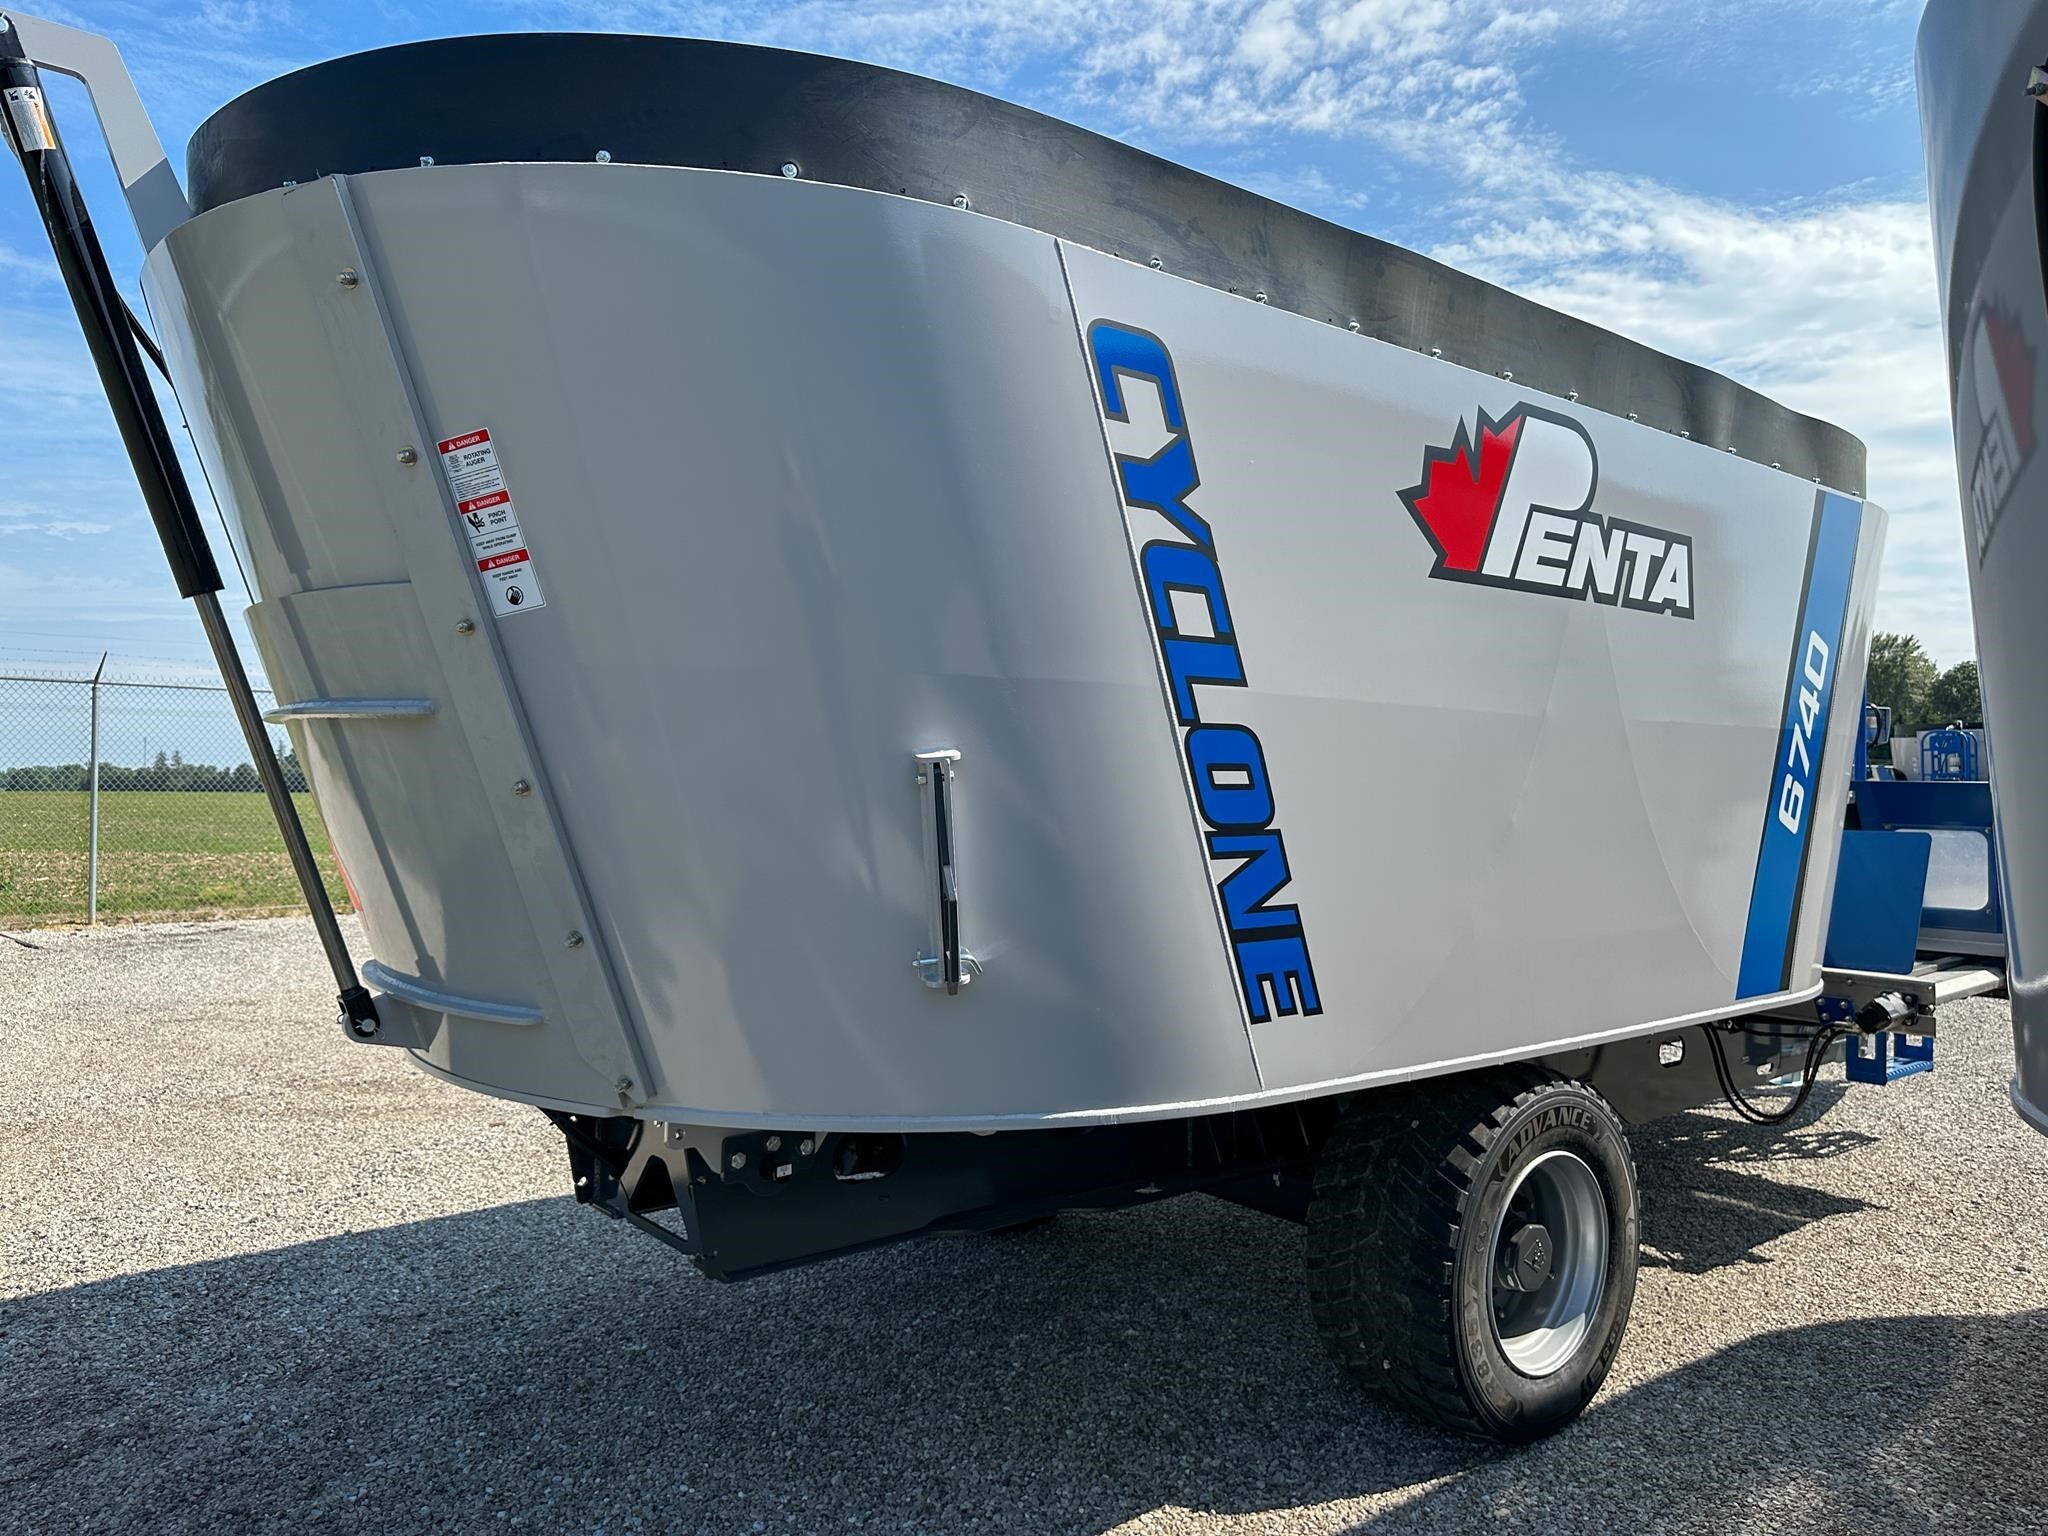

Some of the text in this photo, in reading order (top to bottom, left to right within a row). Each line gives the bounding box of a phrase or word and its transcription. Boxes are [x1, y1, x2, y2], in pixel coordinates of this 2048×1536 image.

[456, 435, 481, 447] DANGER
[463, 447, 491, 461] ROTATING
[465, 456, 486, 467] AUGER
[476, 495, 501, 508] DANGER
[487, 509, 506, 519] PINCH
[1480, 408, 1693, 614] PENTA
[490, 516, 507, 526] POINT
[495, 554, 521, 566] DANGER
[1086, 317, 1324, 1026] CYCLONE
[1777, 629, 1829, 835] 6740
[1508, 1106, 1592, 1168] ADVANCE
